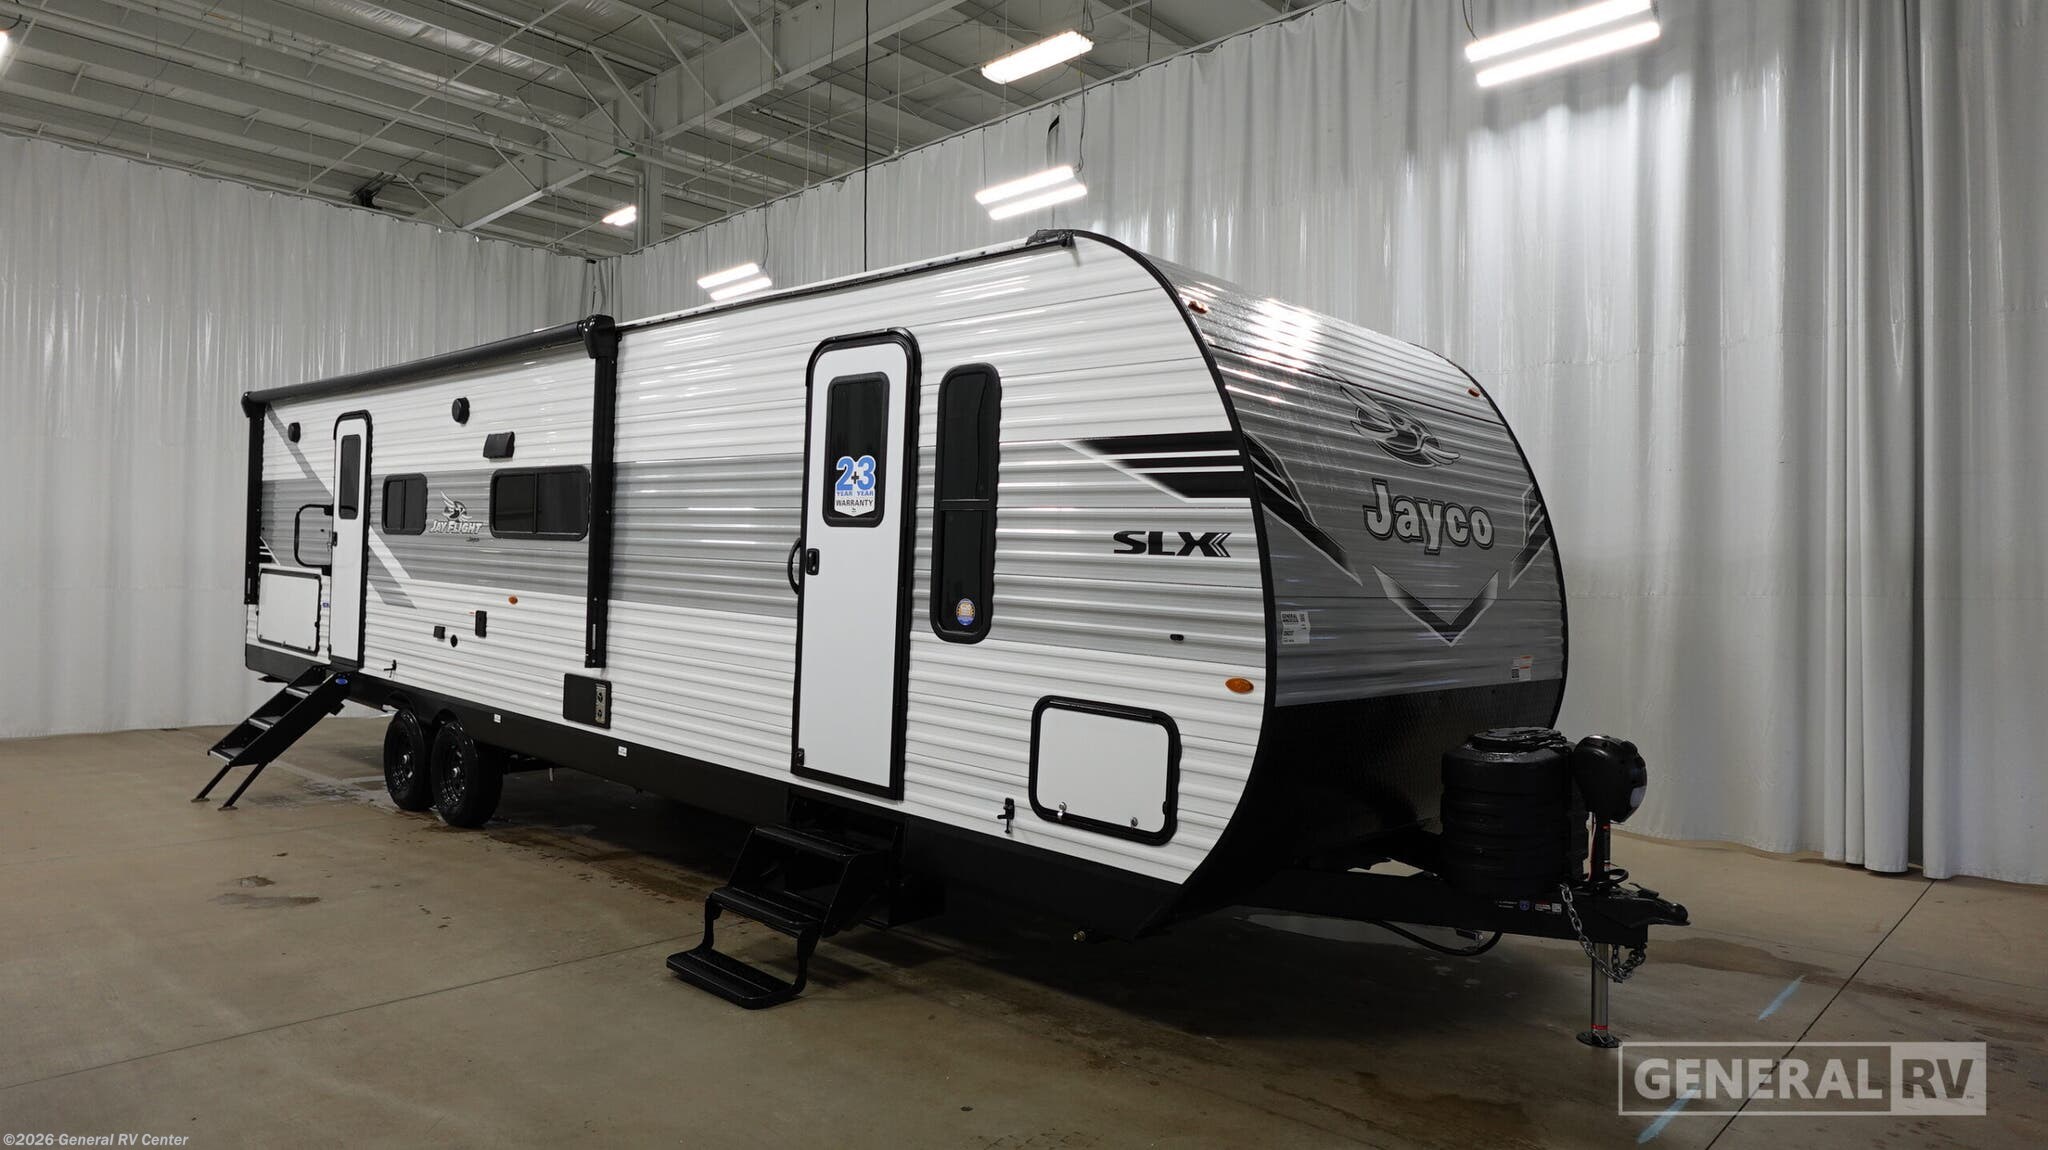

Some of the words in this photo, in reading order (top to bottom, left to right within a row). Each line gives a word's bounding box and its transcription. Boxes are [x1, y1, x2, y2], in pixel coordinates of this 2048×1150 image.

[430, 520, 448, 533] JAY
[448, 520, 483, 534] FLIGHT
[1362, 478, 1495, 556] Jayco
[1113, 530, 1232, 558] SLX
